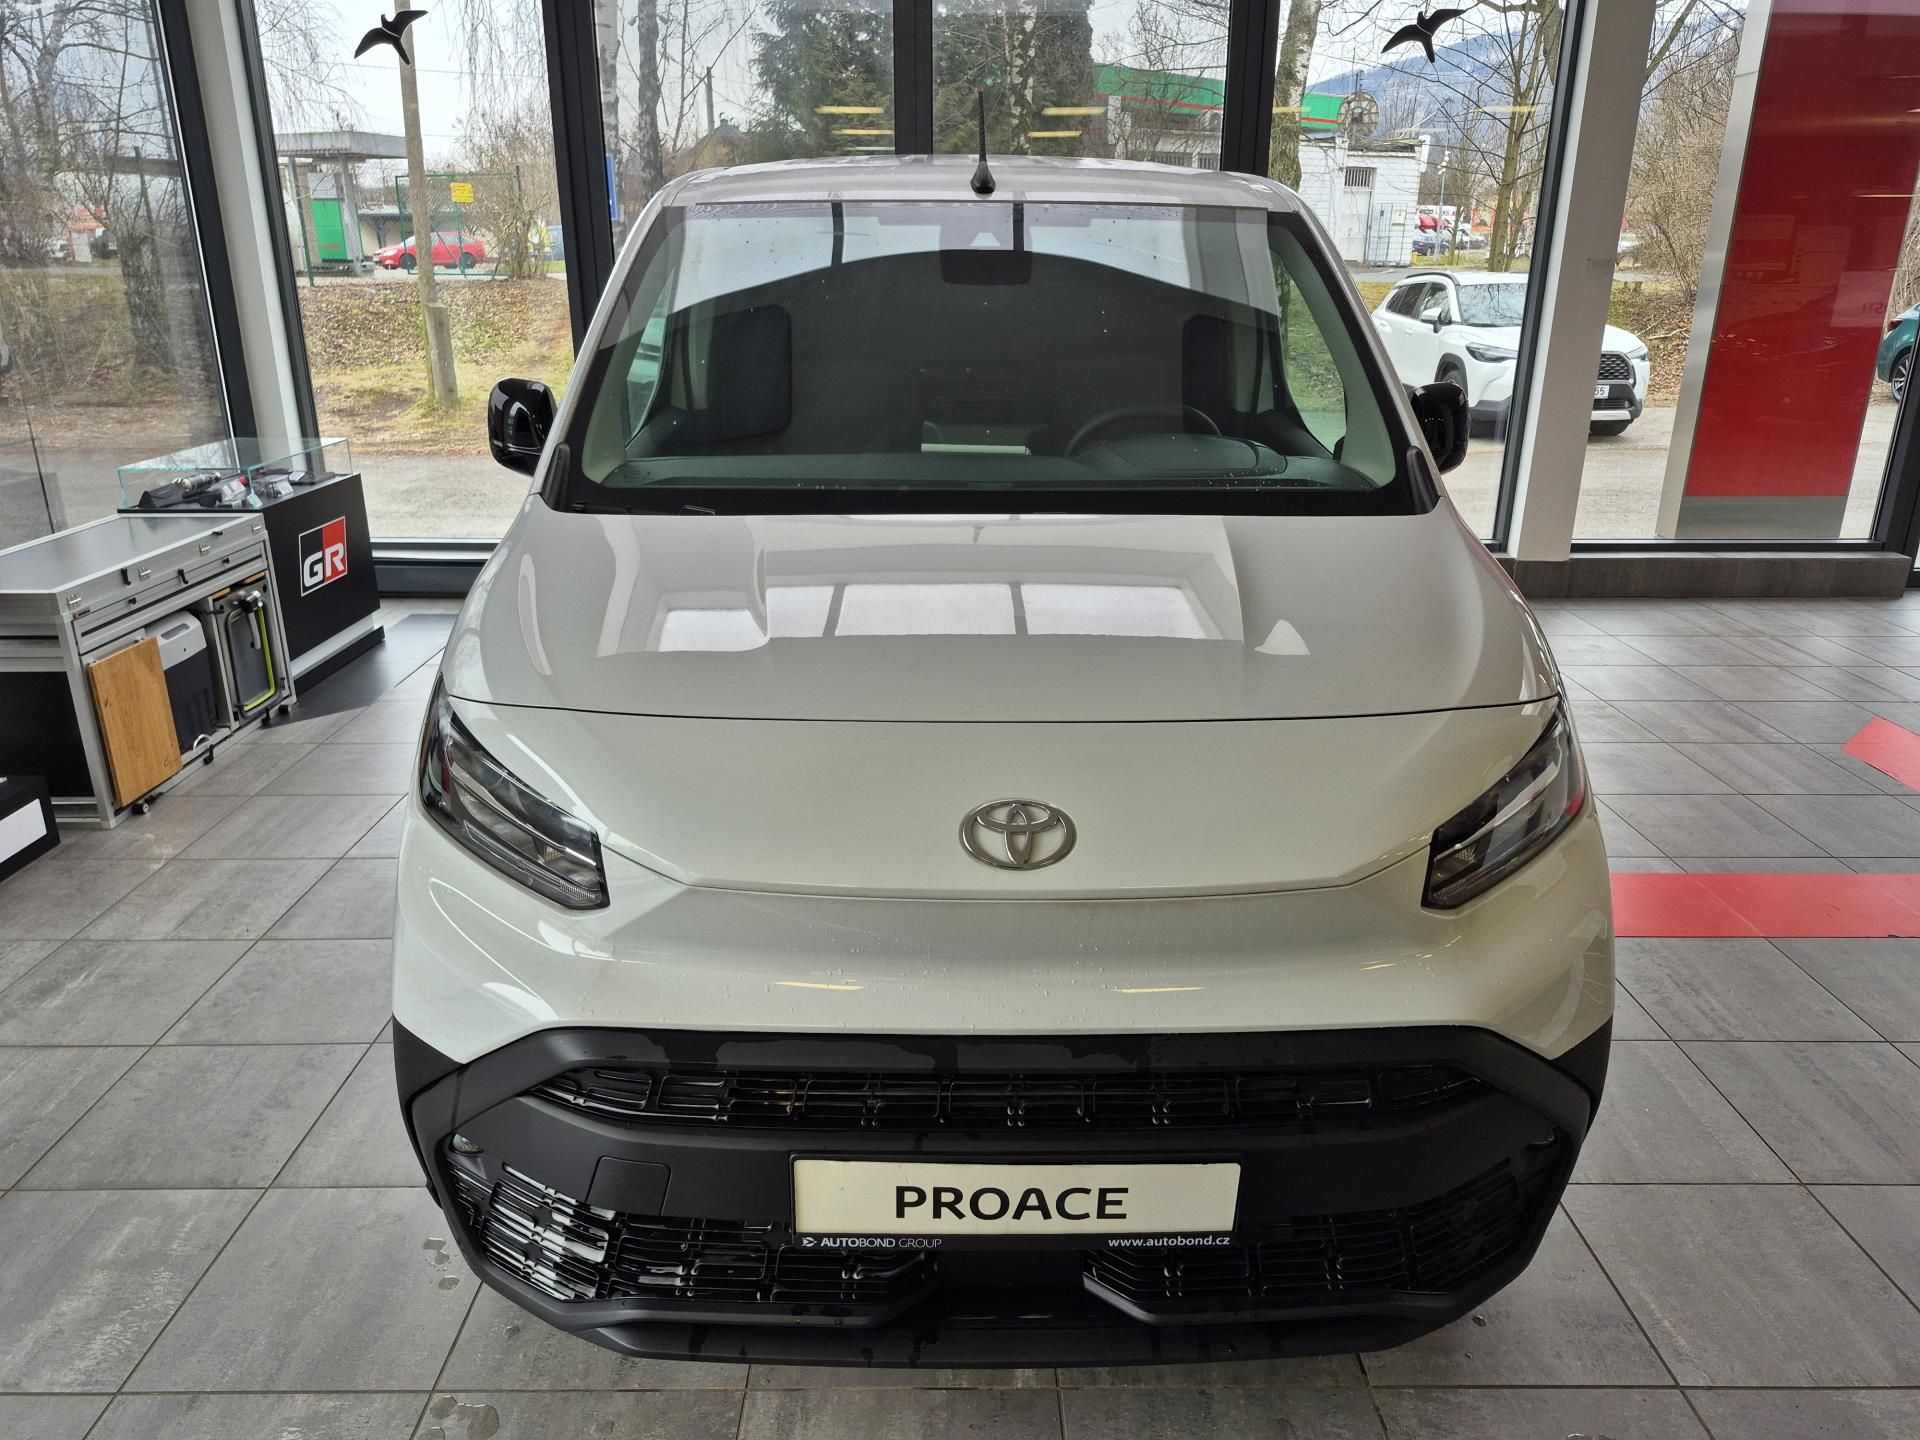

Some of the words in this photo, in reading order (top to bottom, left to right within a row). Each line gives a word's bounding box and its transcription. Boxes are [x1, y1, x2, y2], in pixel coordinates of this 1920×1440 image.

[303, 542, 345, 587] GR
[896, 1185, 1129, 1220] PROACE
[820, 1237, 896, 1248] AUTOBOND
[898, 1238, 942, 1248] GROUP
[1108, 1235, 1231, 1247] www.autobond.cz
